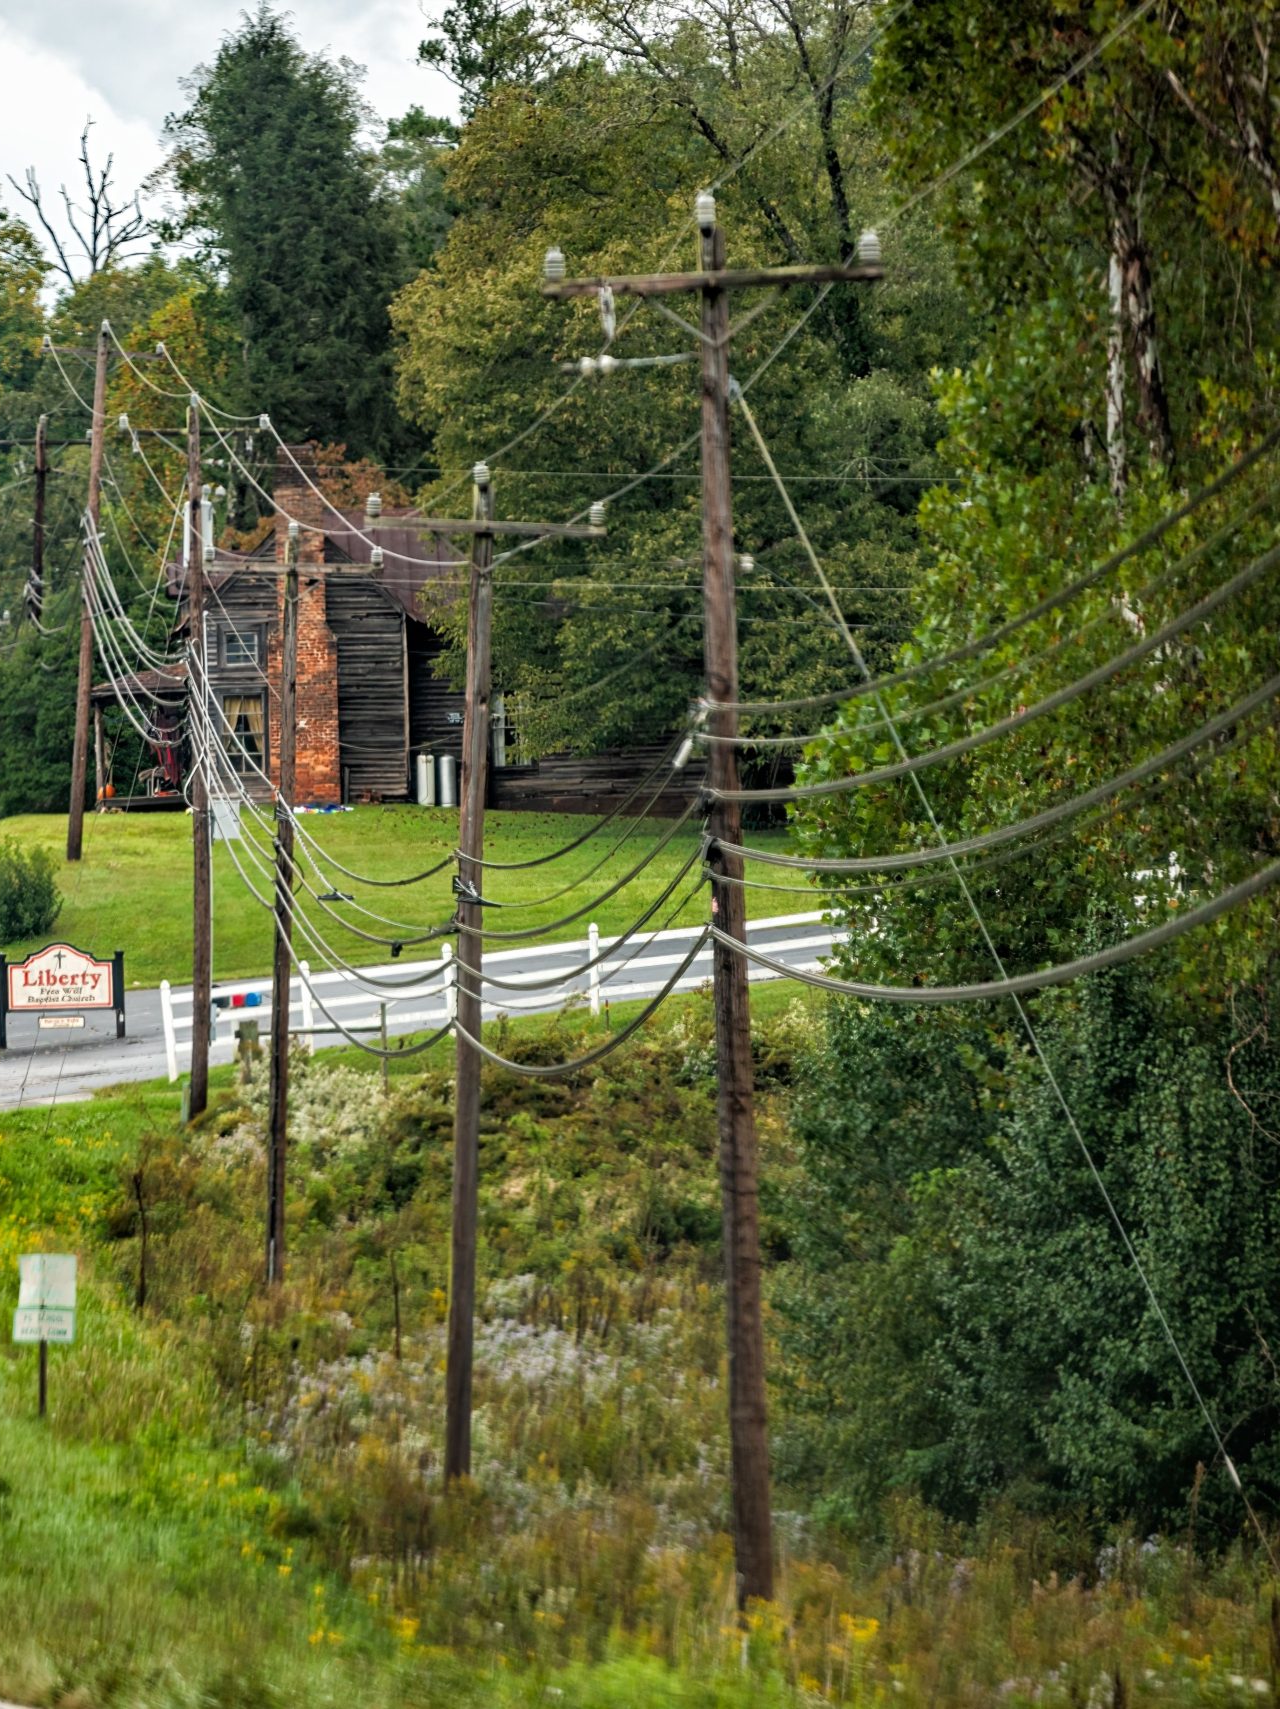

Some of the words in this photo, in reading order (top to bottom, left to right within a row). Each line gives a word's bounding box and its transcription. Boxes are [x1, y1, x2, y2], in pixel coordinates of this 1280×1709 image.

[22, 969, 101, 989] Liberty
[62, 987, 82, 995] Will
[27, 996, 59, 1004] Baptist
[61, 995, 95, 1003] Church
